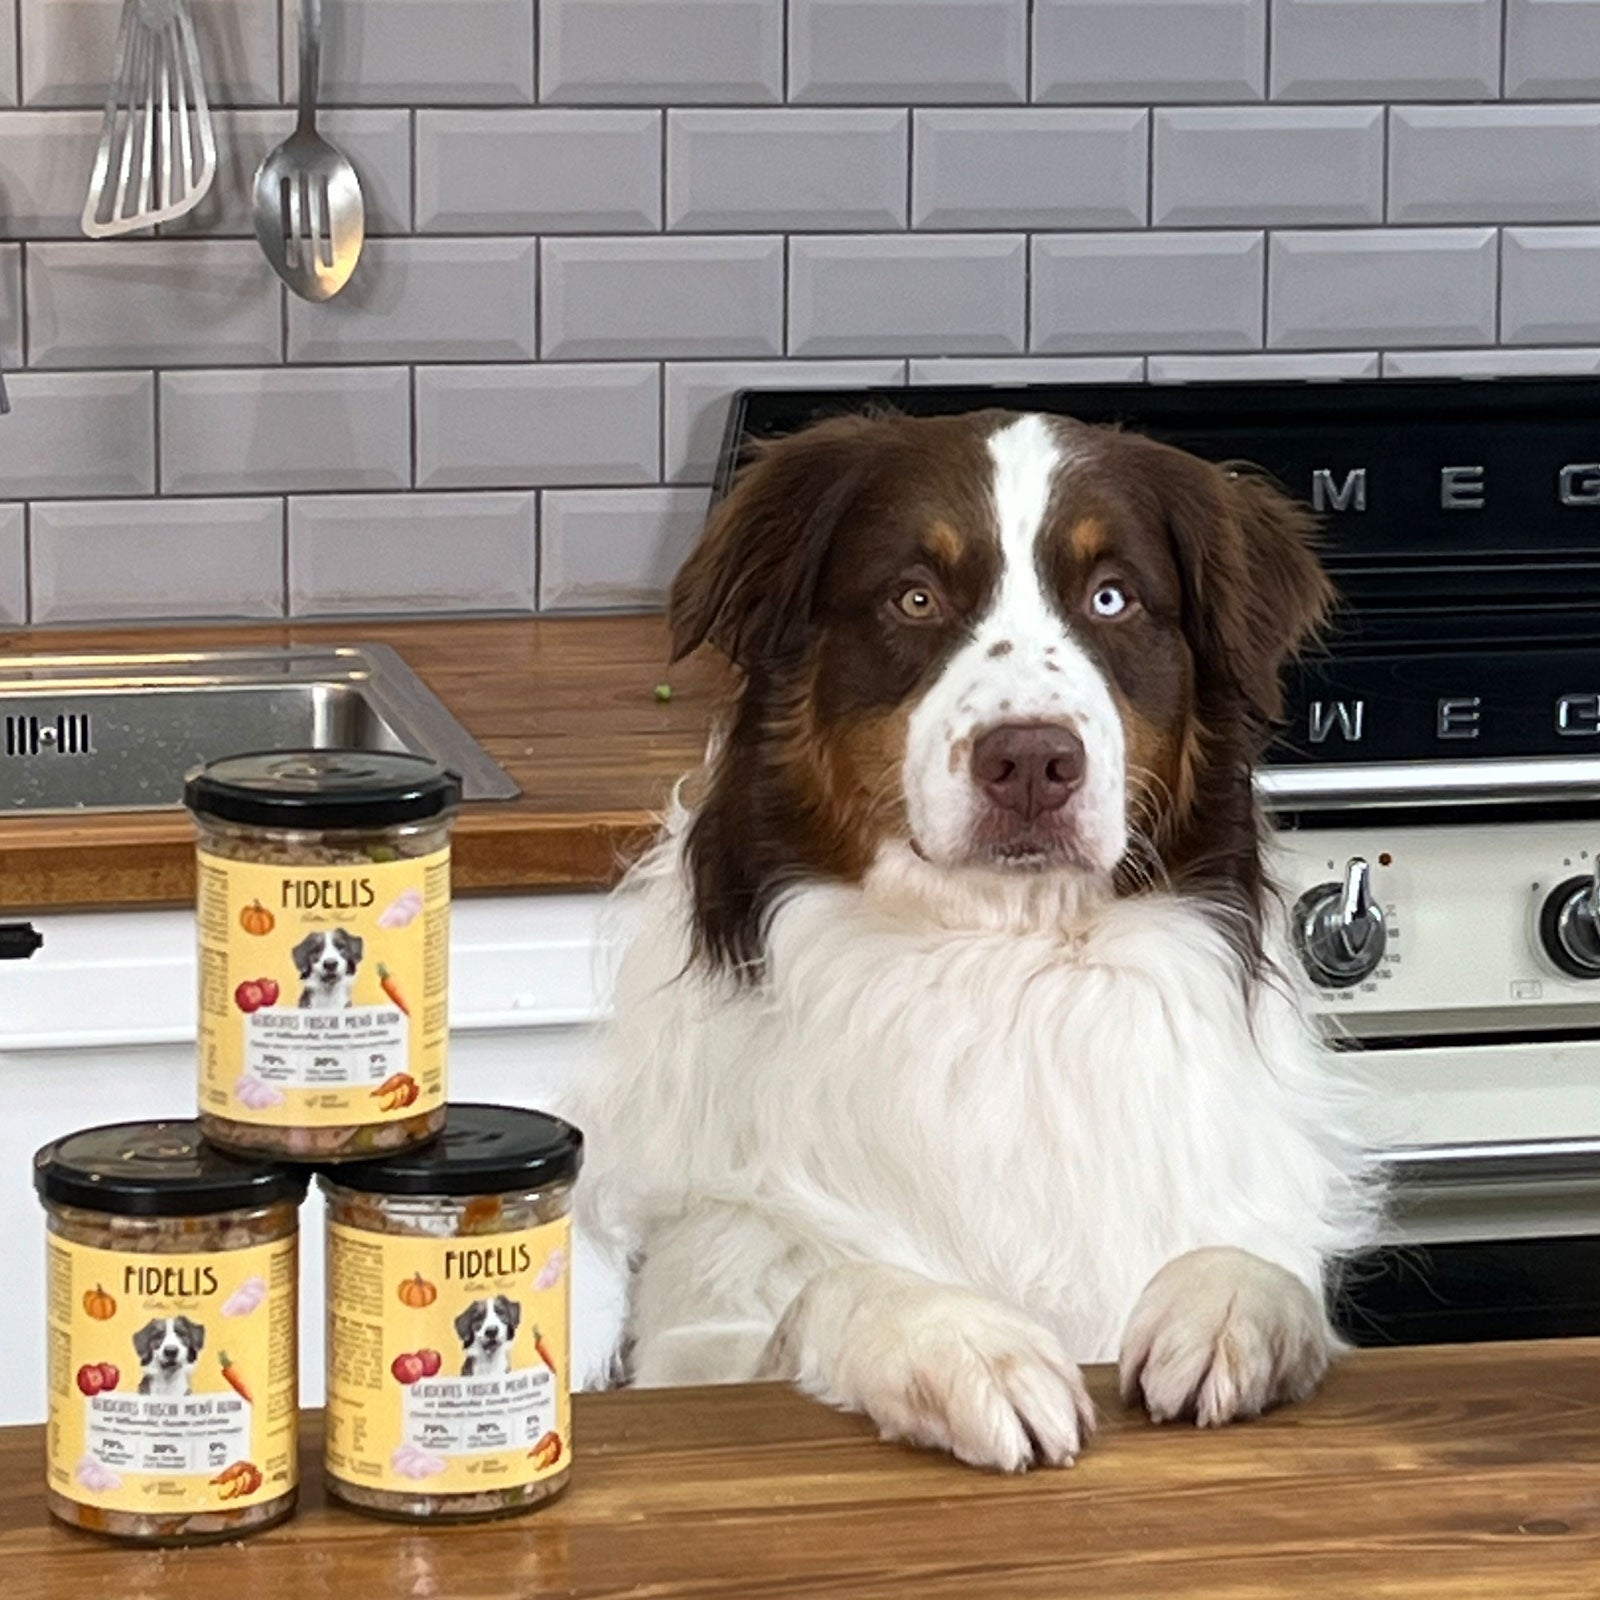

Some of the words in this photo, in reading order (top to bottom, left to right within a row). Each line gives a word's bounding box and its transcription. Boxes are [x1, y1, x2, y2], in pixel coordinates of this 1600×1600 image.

[282, 878, 374, 909] FIDELIS
[445, 1243, 531, 1280] FIDELIS
[124, 1265, 218, 1297] FIDELIS
